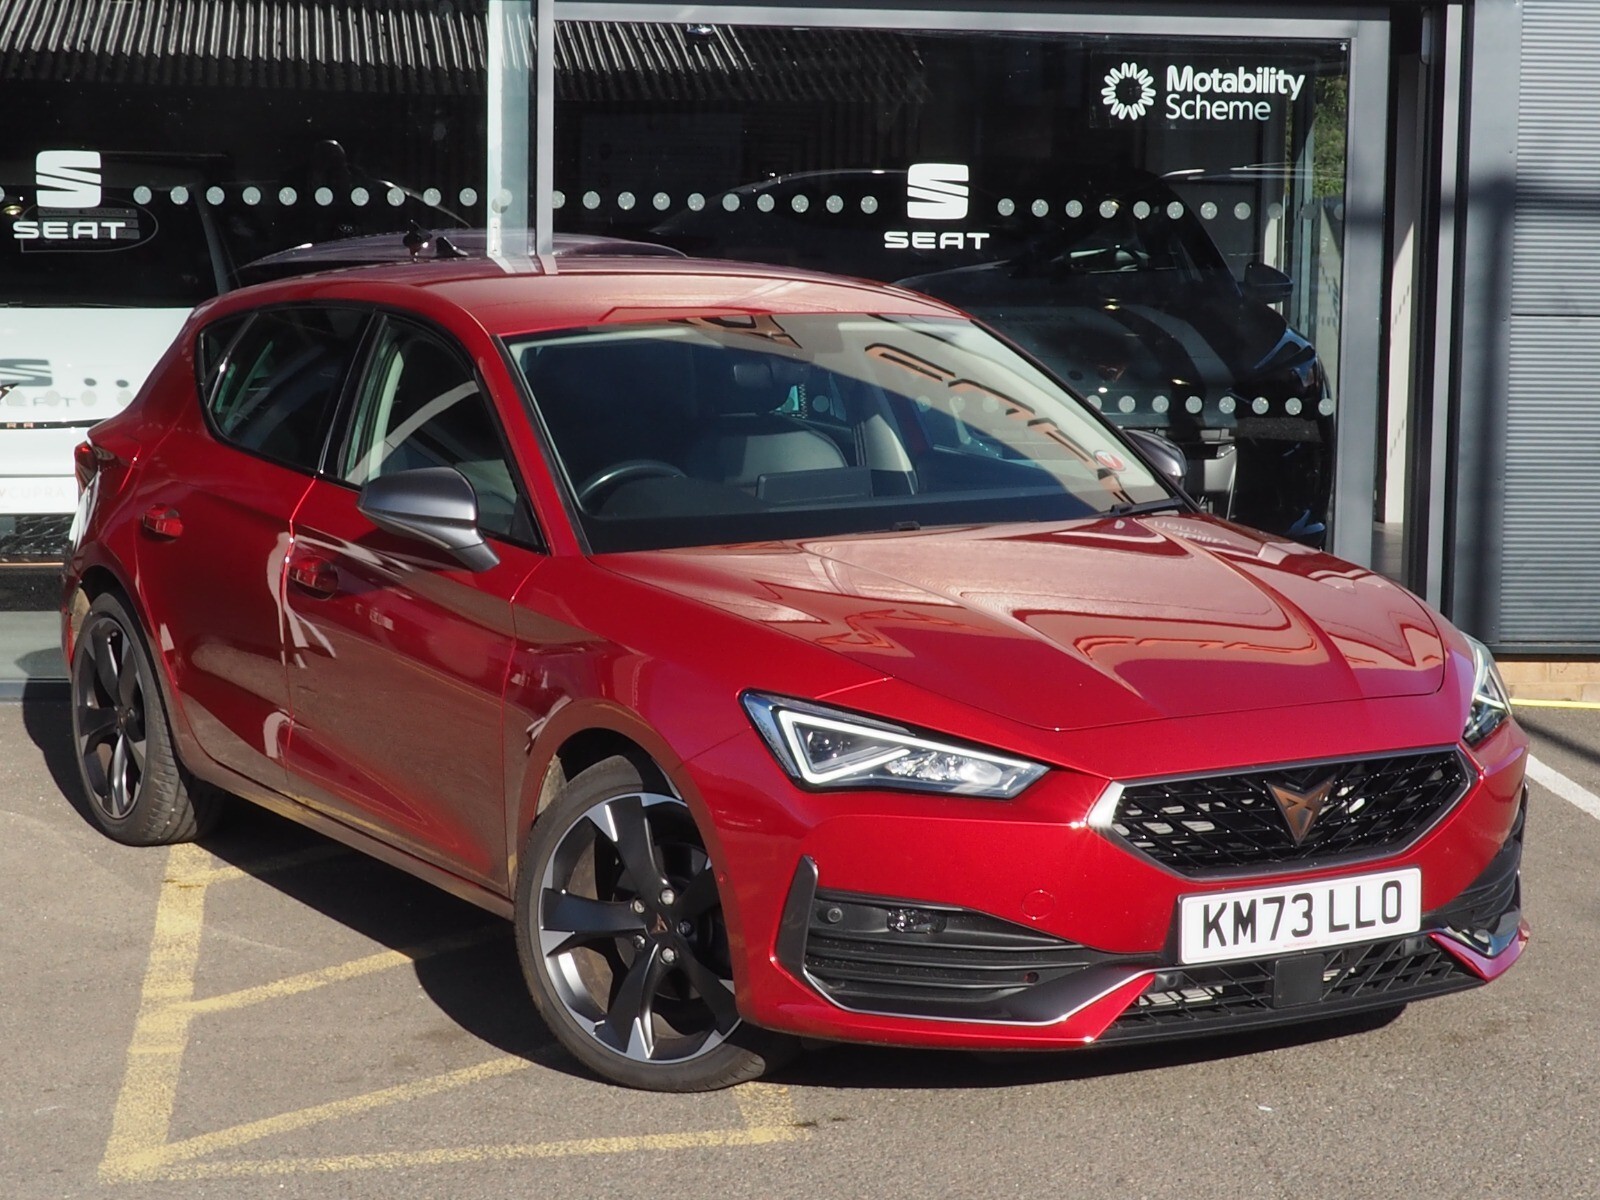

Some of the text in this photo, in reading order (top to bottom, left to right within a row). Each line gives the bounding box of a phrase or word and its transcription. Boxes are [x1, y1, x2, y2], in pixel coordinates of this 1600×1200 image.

[1167, 65, 1305, 101] Motability
[1165, 93, 1271, 121] Scheme
[13, 221, 126, 240] SEAT
[884, 231, 990, 250] SEAT
[1203, 879, 1402, 949] KM73 LLO
